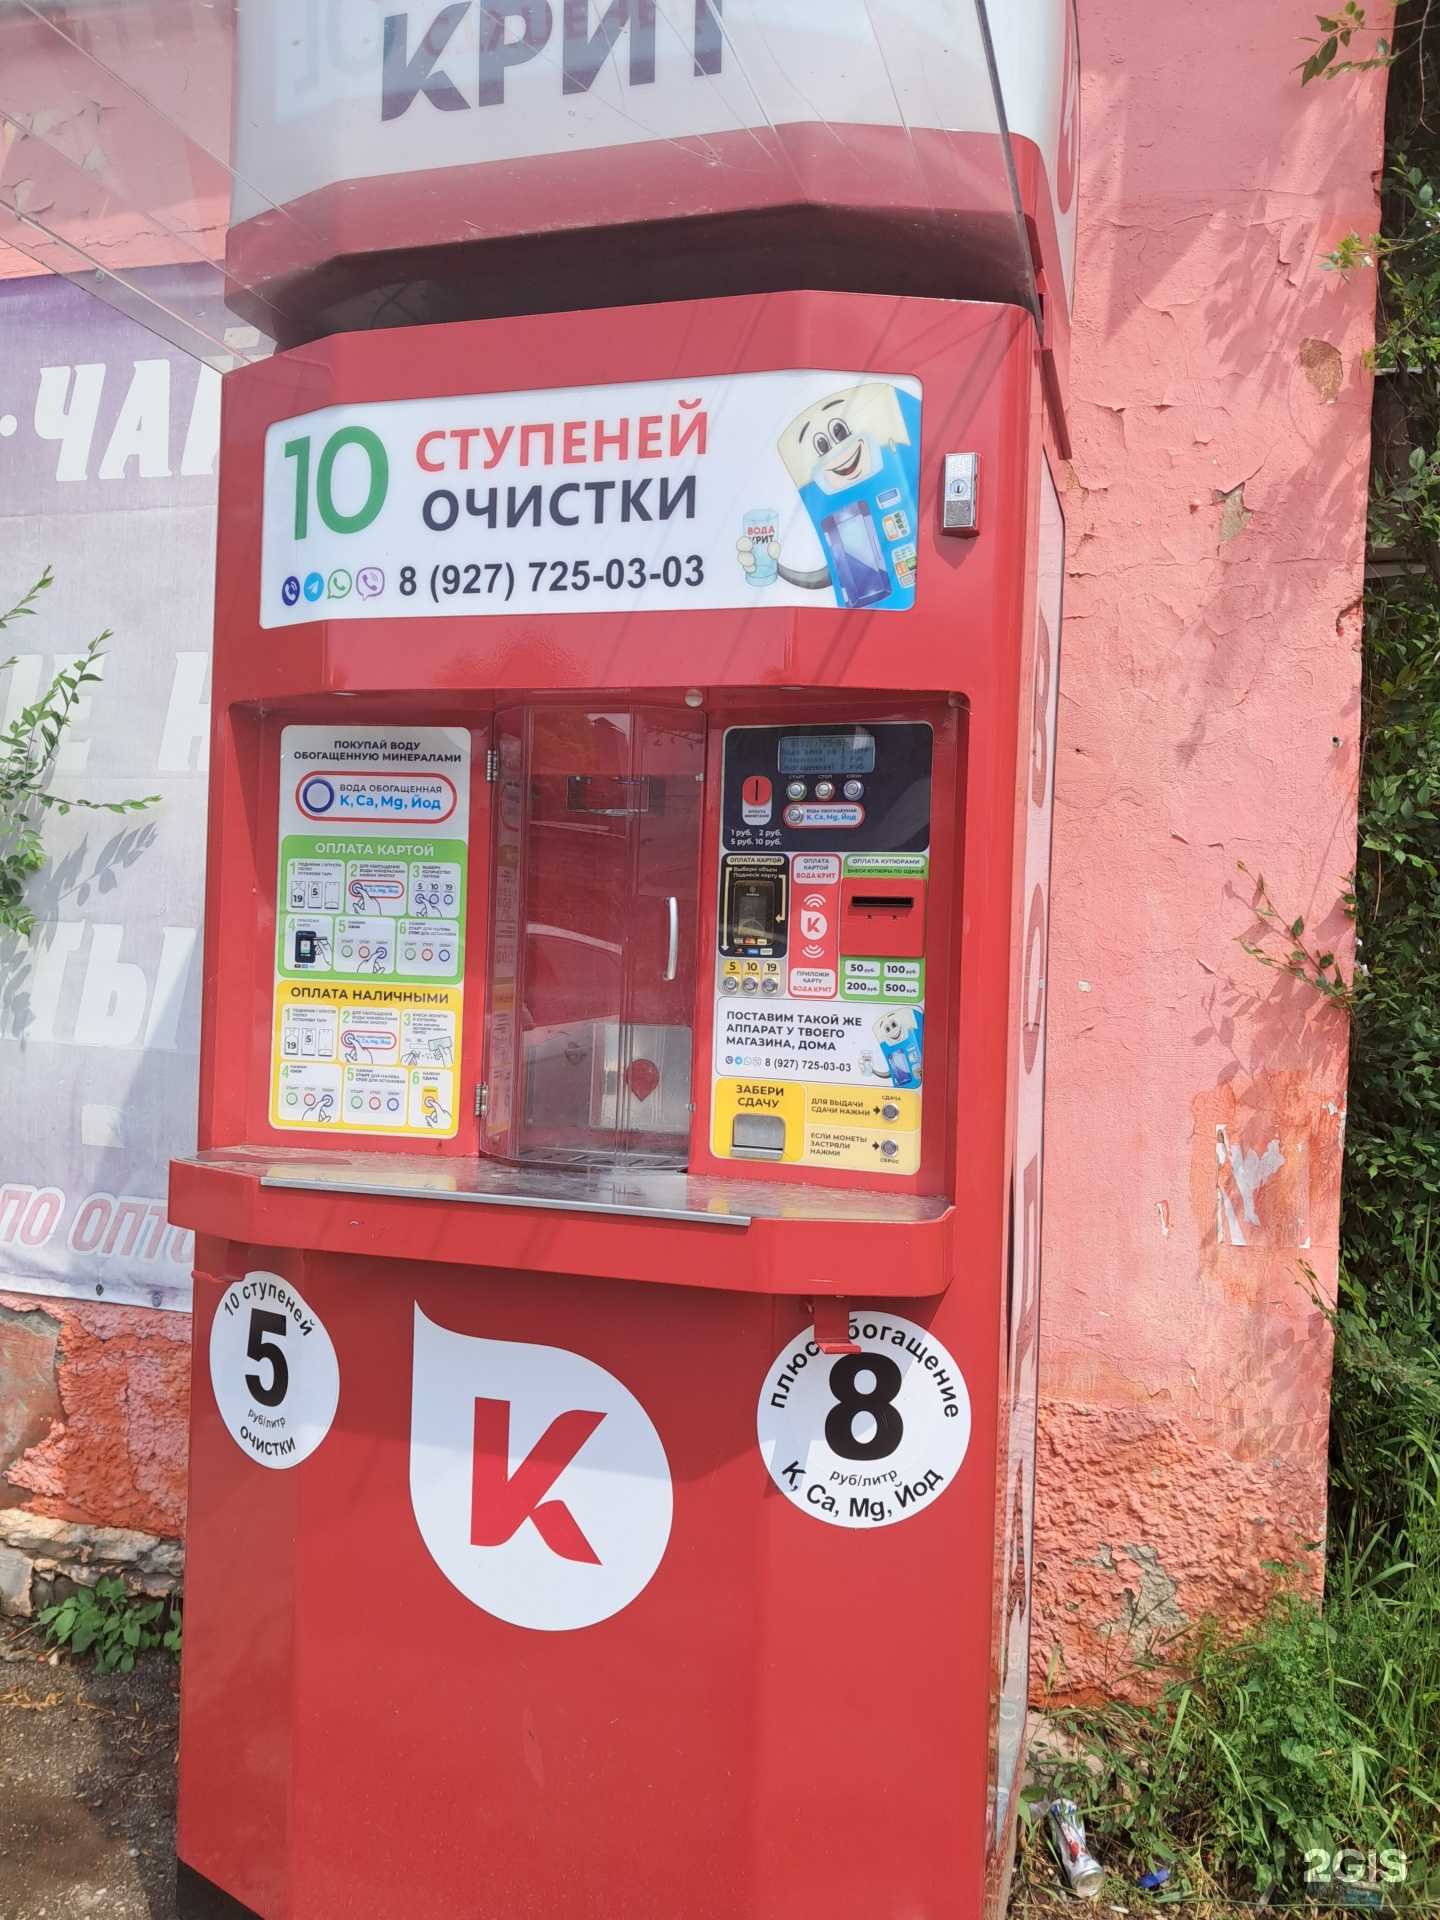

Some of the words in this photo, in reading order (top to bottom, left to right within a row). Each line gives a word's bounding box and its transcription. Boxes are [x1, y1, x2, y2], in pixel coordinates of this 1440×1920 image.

[416, 399, 708, 472] СТУПЕНЕЙ
[284, 425, 389, 541] 10
[422, 475, 697, 531] ОЧИСТКИ
[747, 526, 776, 535] ВОДА
[399, 565, 417, 596] 8
[430, 563, 515, 603] (927)
[529, 554, 705, 593] 725-03-03
[334, 740, 387, 750] ПОКУПАЙ
[390, 741, 421, 751] ВОДУ
[294, 751, 379, 761] ОБОГАЩЕННУЮ
[382, 753, 462, 762] МИНЕРАЛАМИ
[340, 784, 366, 792] ВОДА
[369, 785, 442, 794] ОБОГАЩЕННАЯ
[411, 794, 441, 809] Йод
[315, 843, 373, 855] ОПЛАТА
[377, 843, 434, 857] КАРТОЙ
[729, 962, 736, 971] 5
[746, 962, 757, 971] 10
[767, 963, 777, 972] 19
[850, 963, 864, 972] 50
[887, 965, 905, 974] 100
[847, 982, 867, 990] 200
[885, 983, 906, 992] 500
[290, 987, 348, 1000] ОПЛАТА
[352, 989, 448, 1003] НАЛИЧНЫМИ
[726, 1011, 794, 1023] ПОСТАВИМ
[797, 1013, 838, 1025] ТАКОЙ
[842, 1016, 862, 1026] ЖЕ
[726, 1023, 783, 1035] АППАРАТ
[786, 1027, 796, 1036] У
[799, 1027, 845, 1038] ТВОЕГО
[726, 1037, 795, 1050] МАГАЗИНА,
[798, 1040, 836, 1051] ДОМА
[764, 1059, 771, 1067] 8
[773, 1058, 799, 1070] (927)
[802, 1060, 852, 1072] 725-03-03
[736, 1085, 784, 1096] ЗАБЕРИ
[737, 1097, 780, 1109] СДАЧУ
[811, 1098, 827, 1106] ДЛЯ
[811, 1106, 838, 1114] СДАЧИ
[810, 1132, 831, 1140] ЕСЛИ
[832, 1134, 868, 1143] МОНЕТЫ
[810, 1140, 850, 1149] ЗАСТРЯЛИ
[810, 1149, 841, 1157] НАЖМИ
[72, 1198, 192, 1264] ОПТ
[224, 1293, 240, 1316] 10
[242, 1282, 315, 1336] ступеней
[245, 1308, 288, 1407] 5
[771, 1341, 820, 1409] плюс
[847, 1318, 959, 1418] богащение
[824, 1352, 904, 1461] 8
[248, 1408, 286, 1429] руб/литр
[470, 1396, 608, 1566] К
[829, 1469, 898, 1486] руб/литр
[850, 1498, 892, 1522] Mg,
[894, 1469, 944, 1508] Йод
